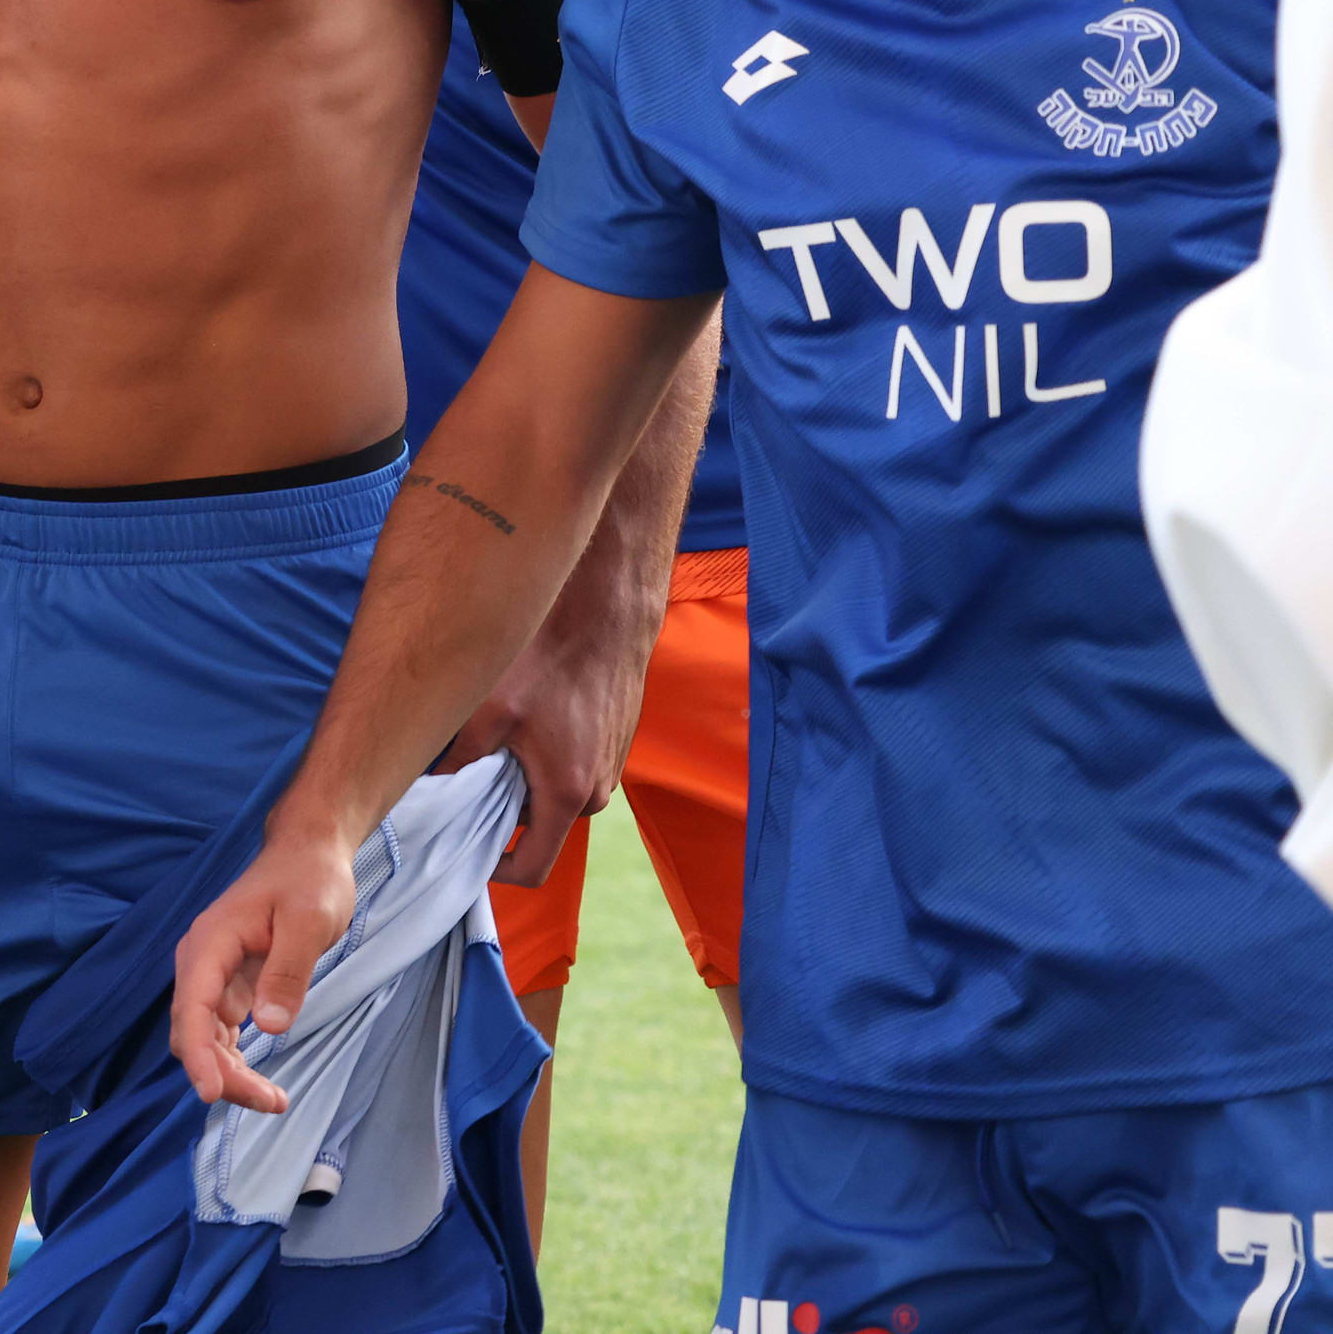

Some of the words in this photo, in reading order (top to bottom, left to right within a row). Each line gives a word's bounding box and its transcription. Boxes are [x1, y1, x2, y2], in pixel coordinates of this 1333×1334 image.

[1037, 87, 1218, 158] פתח-תקוה
[757, 200, 1113, 322] TWO
[885, 321, 1106, 422] NIL
[1217, 1207, 1333, 1334] 7
